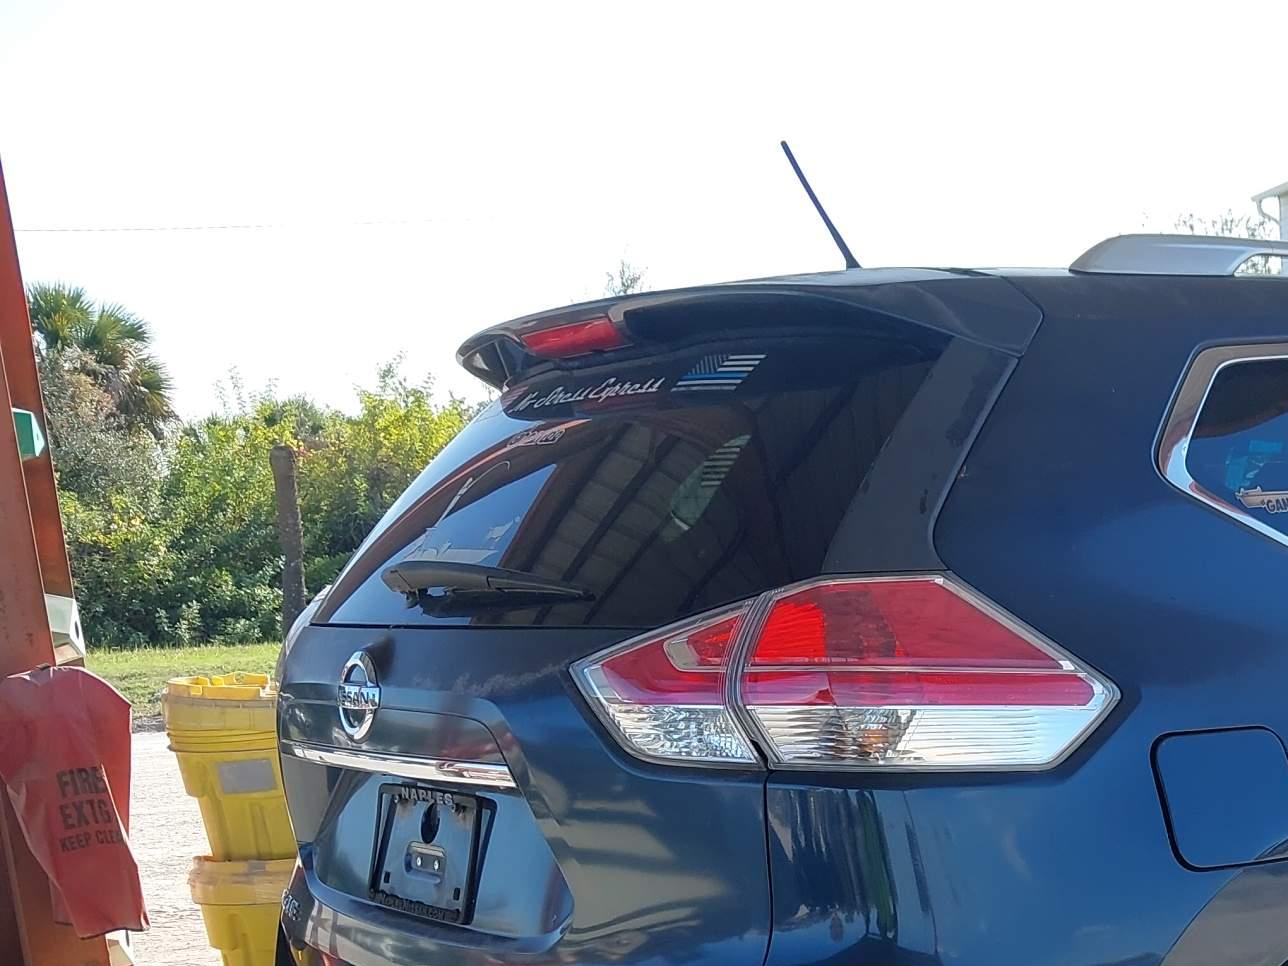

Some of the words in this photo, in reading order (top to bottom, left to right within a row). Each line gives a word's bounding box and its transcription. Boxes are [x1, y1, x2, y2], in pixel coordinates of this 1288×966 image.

[56, 766, 108, 798] FIRE
[401, 786, 453, 804] NAPLES
[60, 832, 91, 852] KEEP
